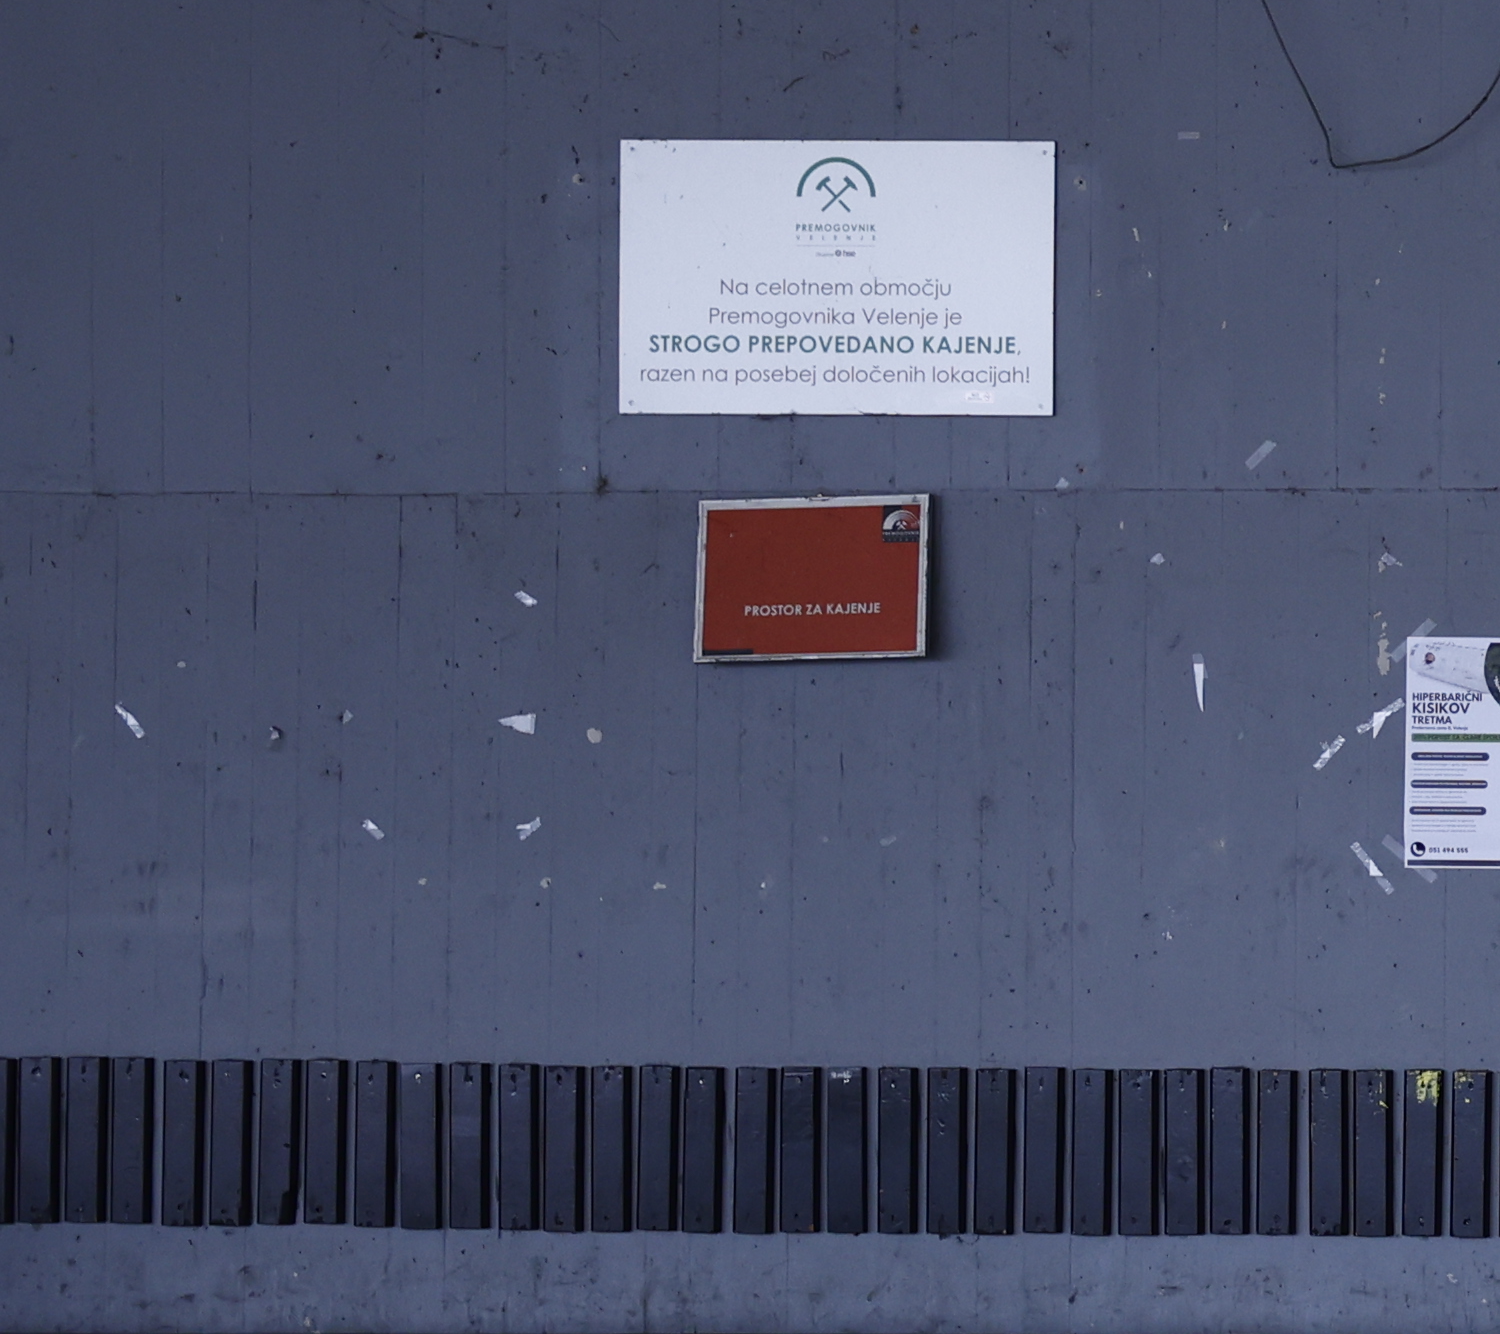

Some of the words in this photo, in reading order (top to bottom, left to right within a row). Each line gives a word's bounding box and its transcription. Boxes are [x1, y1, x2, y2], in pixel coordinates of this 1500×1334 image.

[795, 224, 877, 232] PREMOGOVNIK
[719, 279, 748, 296] Na
[755, 278, 853, 296] celotnem
[860, 278, 952, 300] območju
[709, 307, 855, 329] Premogovnika
[862, 307, 938, 329] Velenje
[942, 308, 962, 329] je
[649, 335, 740, 354] STROGO
[749, 335, 914, 354] PREPOVEDANO
[923, 336, 1021, 357] KAJENJE,
[640, 368, 695, 383] razen
[702, 368, 728, 383] na
[736, 365, 817, 386] posebej
[823, 364, 926, 384] določenih
[932, 365, 1030, 387] lokacijah!
[744, 604, 802, 617] PROSTOR
[806, 603, 822, 615] ZA
[826, 602, 881, 615] KAJENJE
[1412, 690, 1483, 702] HIPERBARIČNI
[1412, 703, 1470, 714] KISIKOV
[1412, 716, 1452, 725] TRETMA
